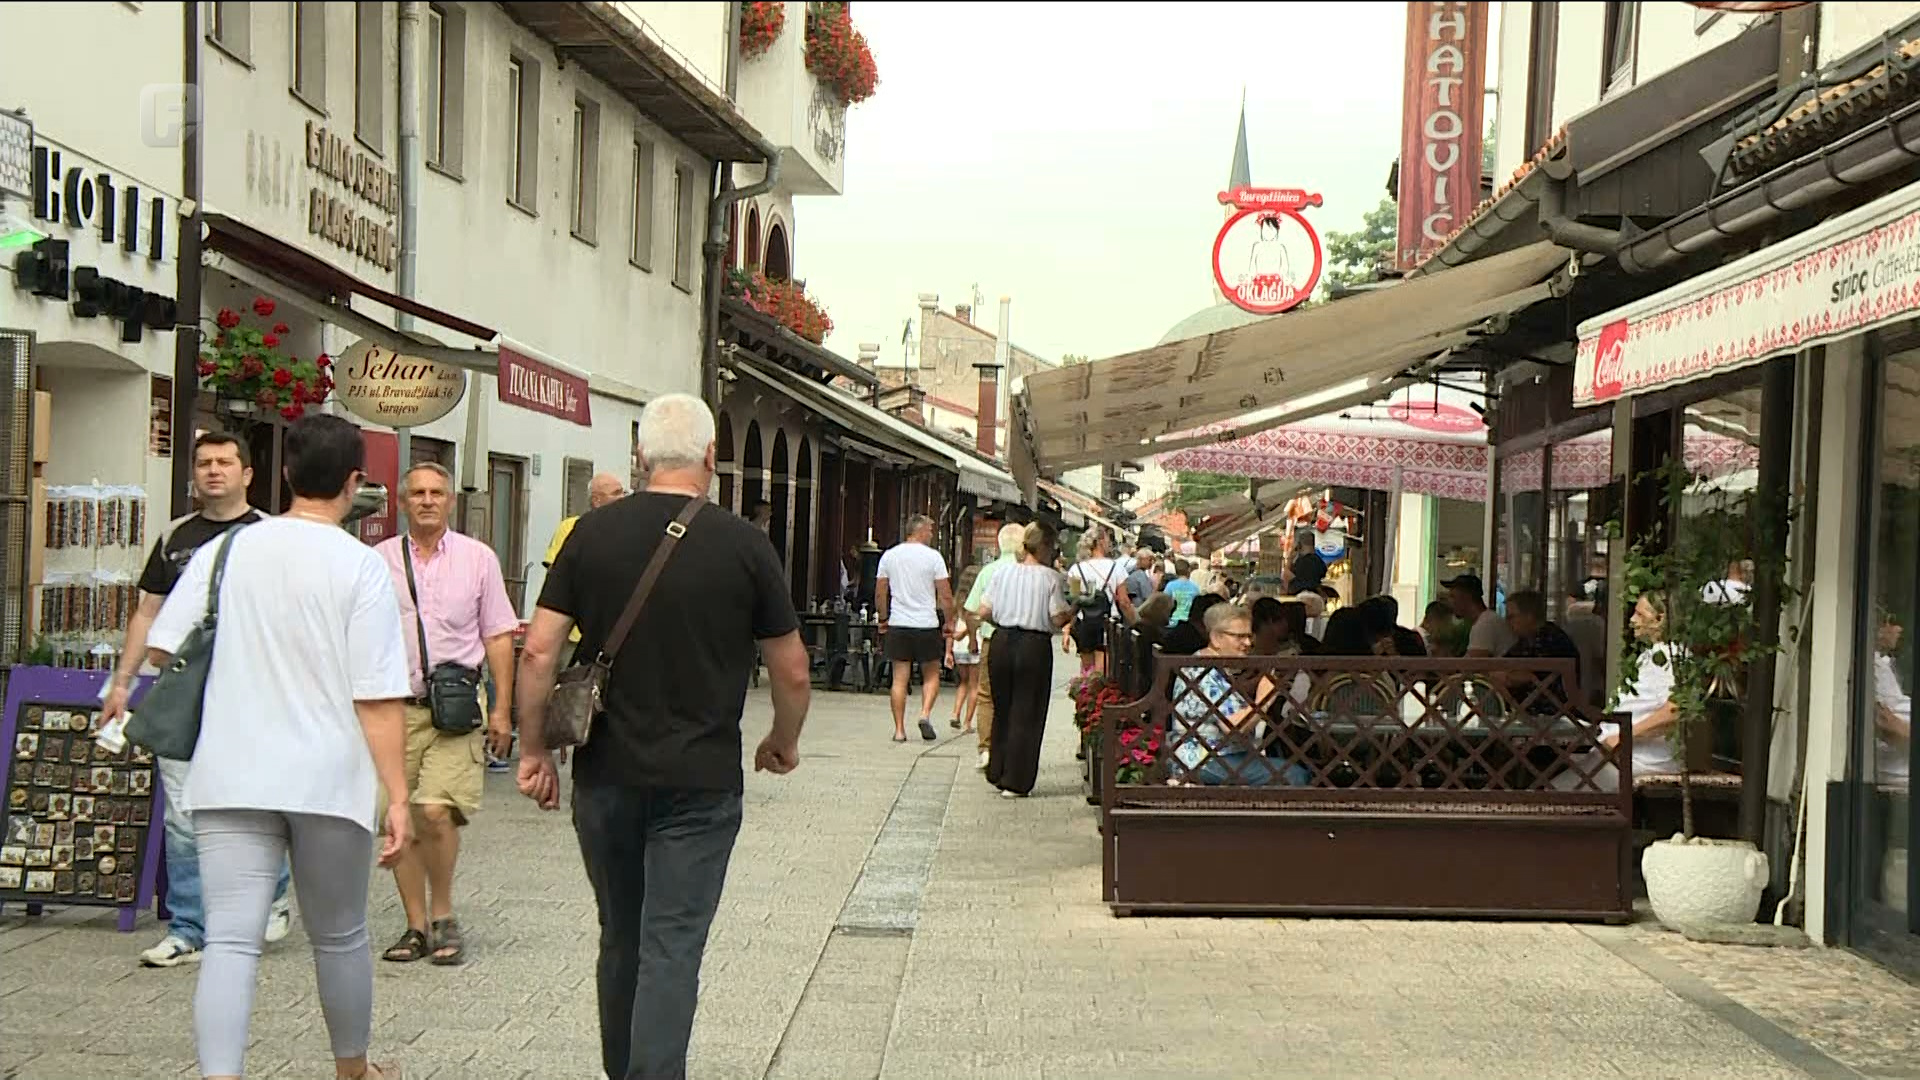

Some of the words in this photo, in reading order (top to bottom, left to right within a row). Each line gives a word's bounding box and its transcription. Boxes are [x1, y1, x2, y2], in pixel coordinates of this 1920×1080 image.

[1423, 3, 1466, 241] HATOVIĆ
[348, 343, 434, 381] Šehar
[375, 401, 419, 417] Sarajevo
